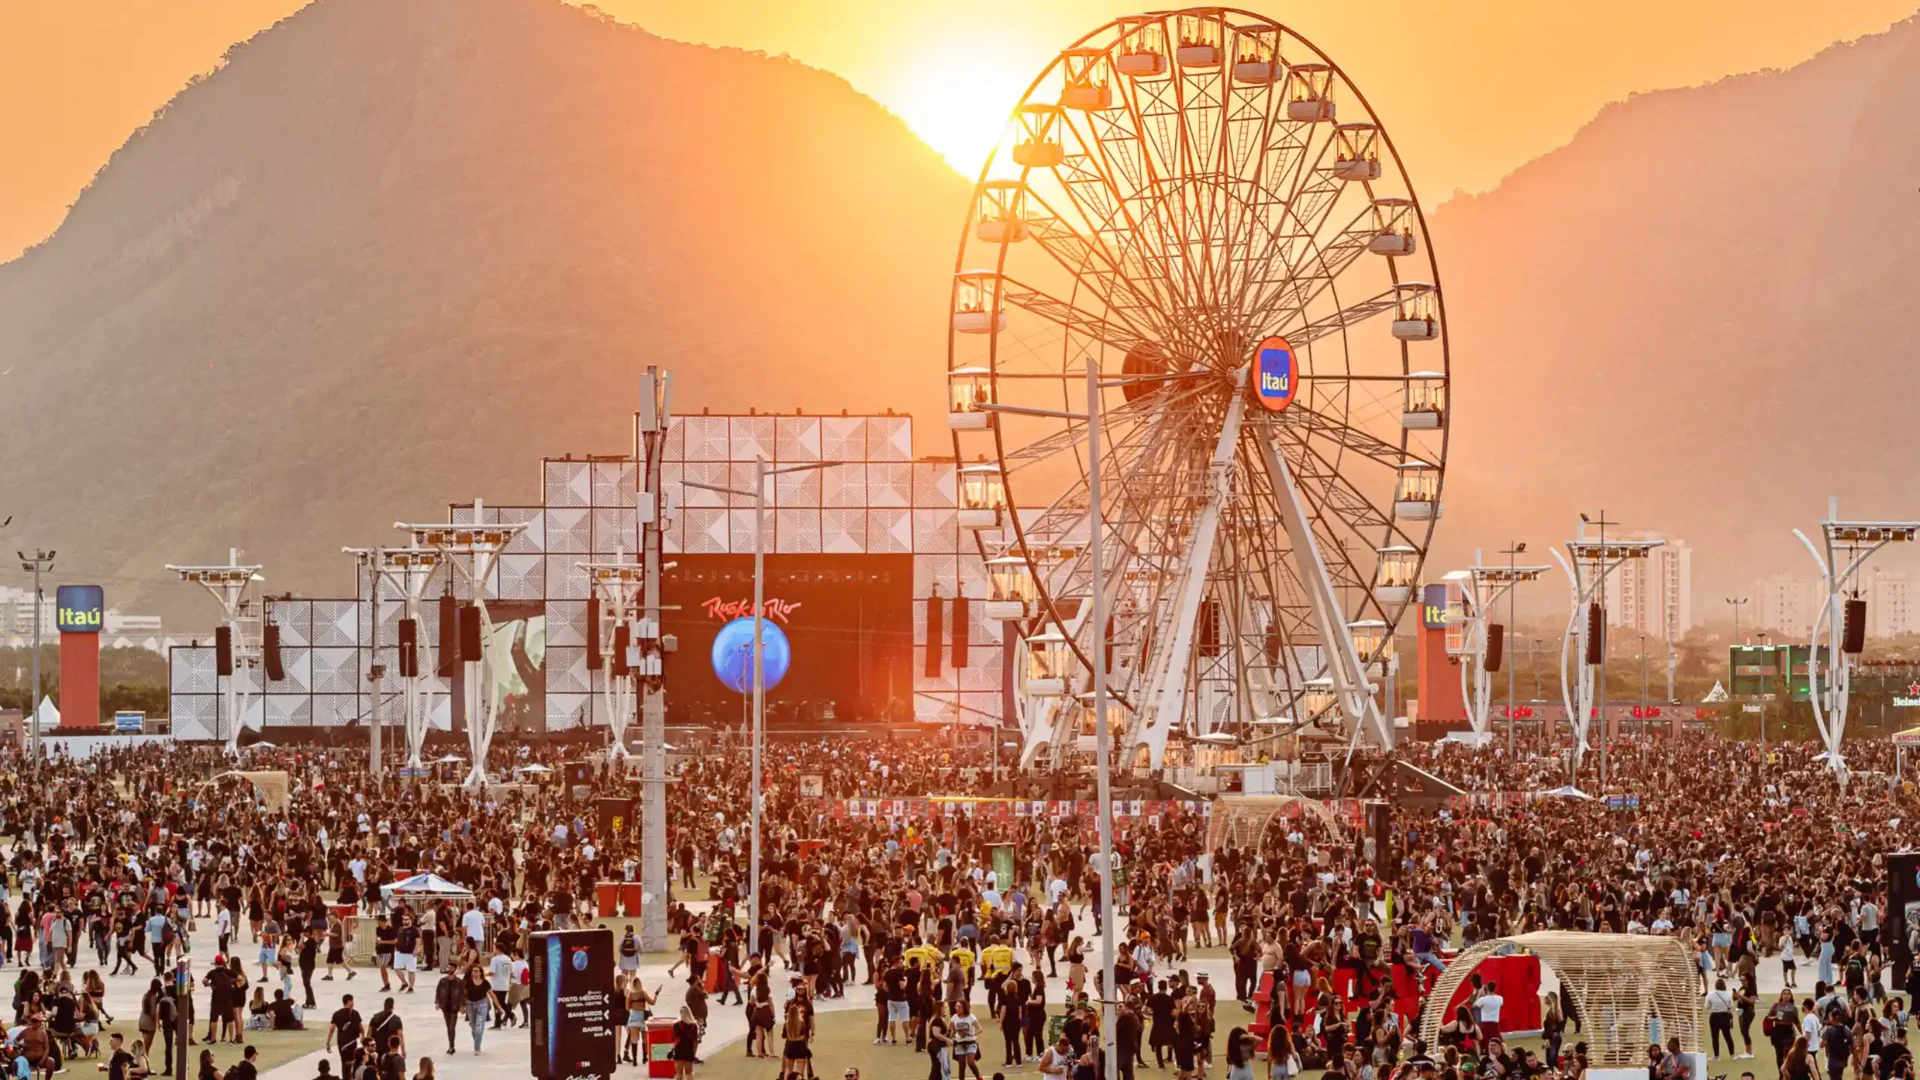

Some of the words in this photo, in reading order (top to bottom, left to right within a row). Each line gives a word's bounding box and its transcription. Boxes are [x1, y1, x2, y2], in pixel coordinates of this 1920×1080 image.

[1262, 372, 1288, 391] Itaú
[59, 607, 101, 625] Itaú
[701, 597, 750, 622] Rock
[764, 597, 802, 624] Rio
[1425, 605, 1454, 623] Ita
[1892, 697, 1920, 707] Heine
